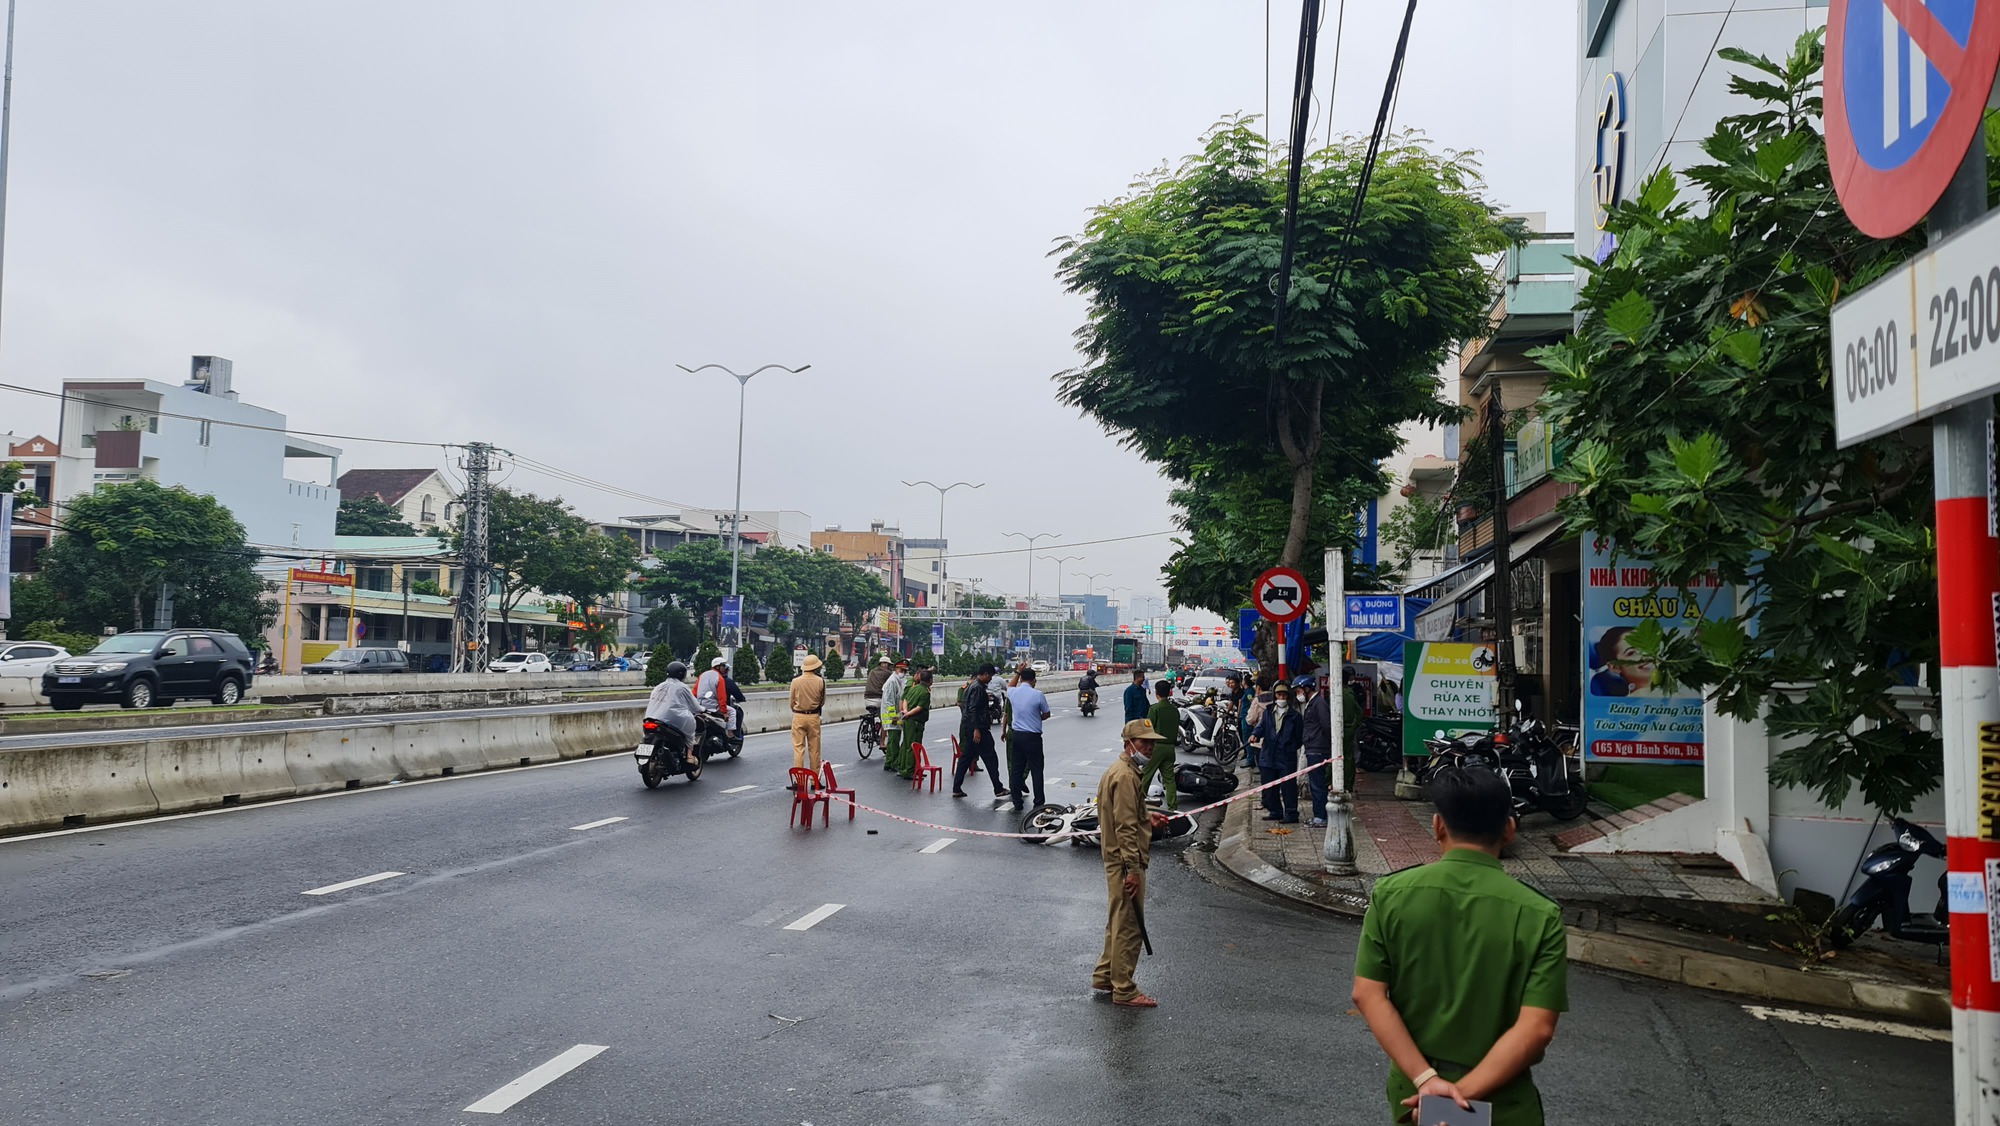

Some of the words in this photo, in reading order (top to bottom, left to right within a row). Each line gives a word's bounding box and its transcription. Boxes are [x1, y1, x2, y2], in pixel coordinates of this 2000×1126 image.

[1846, 319, 1898, 404] 06:00
[1929, 266, 2000, 369] 22:00
[1365, 599, 1393, 608] ĐƯỜNG
[1351, 611, 1368, 625] TRẦN
[1369, 612, 1384, 625] VĂN
[1427, 656, 1451, 665] Rửa
[1430, 679, 1484, 690] CHUYÊN
[1433, 691, 1460, 702] RỬA
[1464, 694, 1481, 703] XE
[1420, 706, 1454, 716] THAY
[1458, 707, 1494, 717] NHỚT
[1595, 743, 1612, 753] 165
[1615, 743, 1633, 756] Ngũ
[1636, 743, 1660, 755] Hành
[1663, 745, 1683, 757] Sơn,
[1686, 745, 1699, 756] Đà
